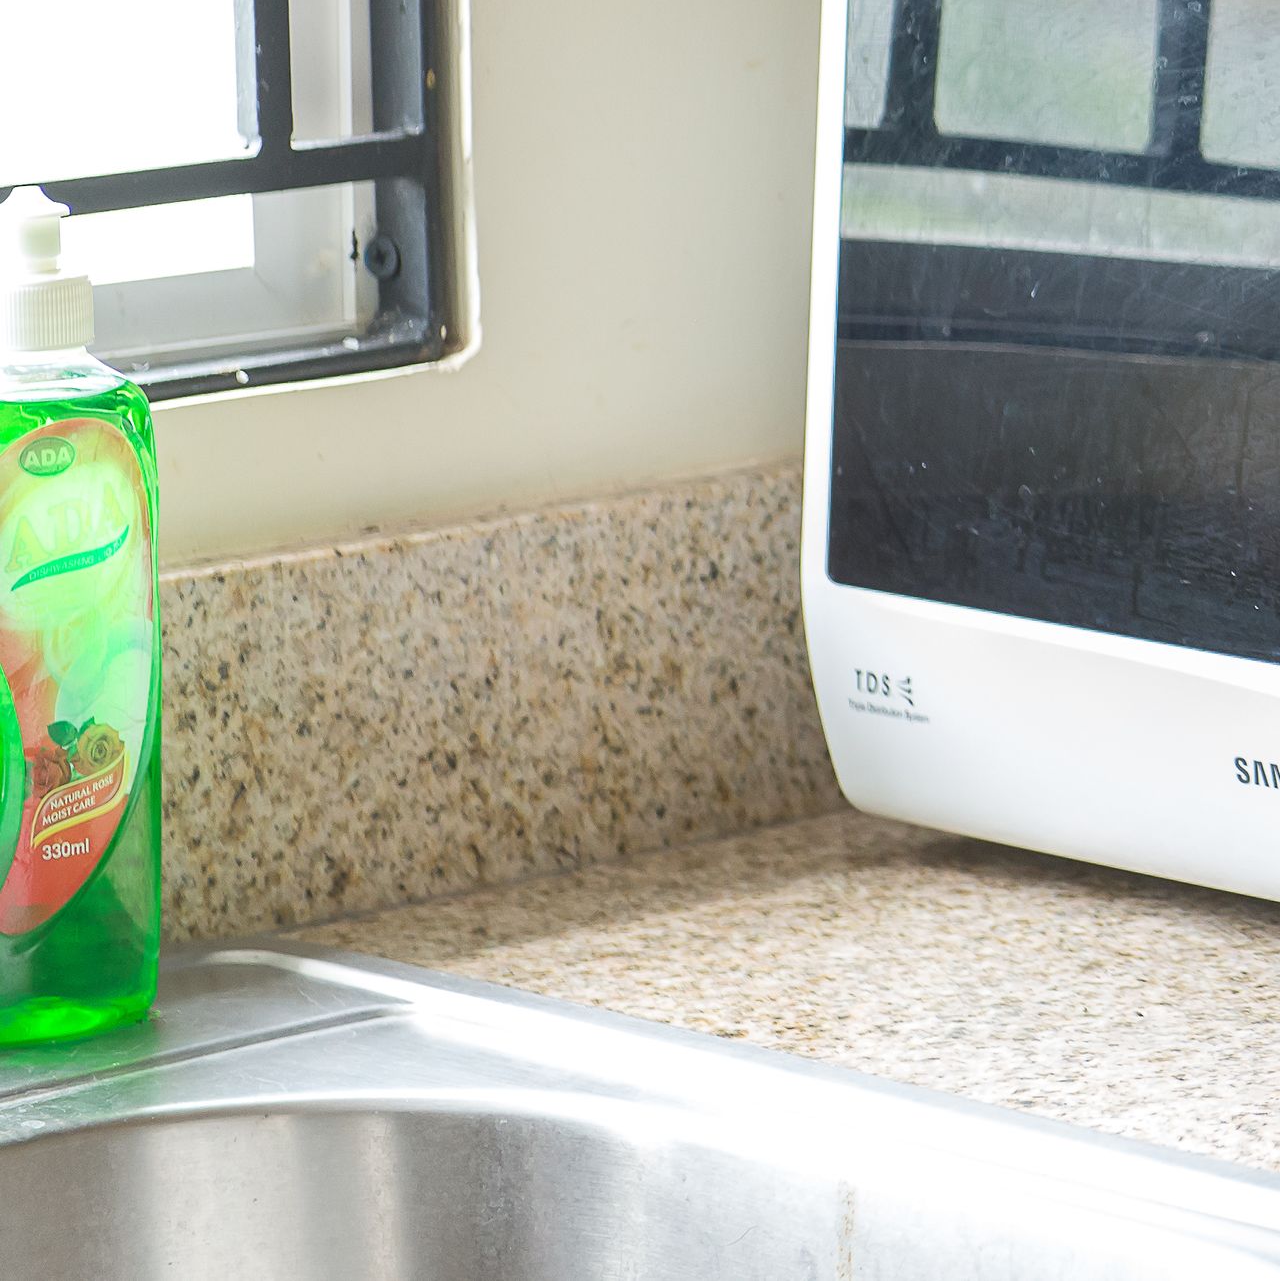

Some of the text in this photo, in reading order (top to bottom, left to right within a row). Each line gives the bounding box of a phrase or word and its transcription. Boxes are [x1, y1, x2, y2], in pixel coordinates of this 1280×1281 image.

[25, 446, 72, 468] ADA
[854, 667, 891, 697] TDS
[50, 773, 114, 810] NATURAL ROSE
[42, 795, 96, 827] MOIST CARE
[42, 837, 90, 861] 330ml
